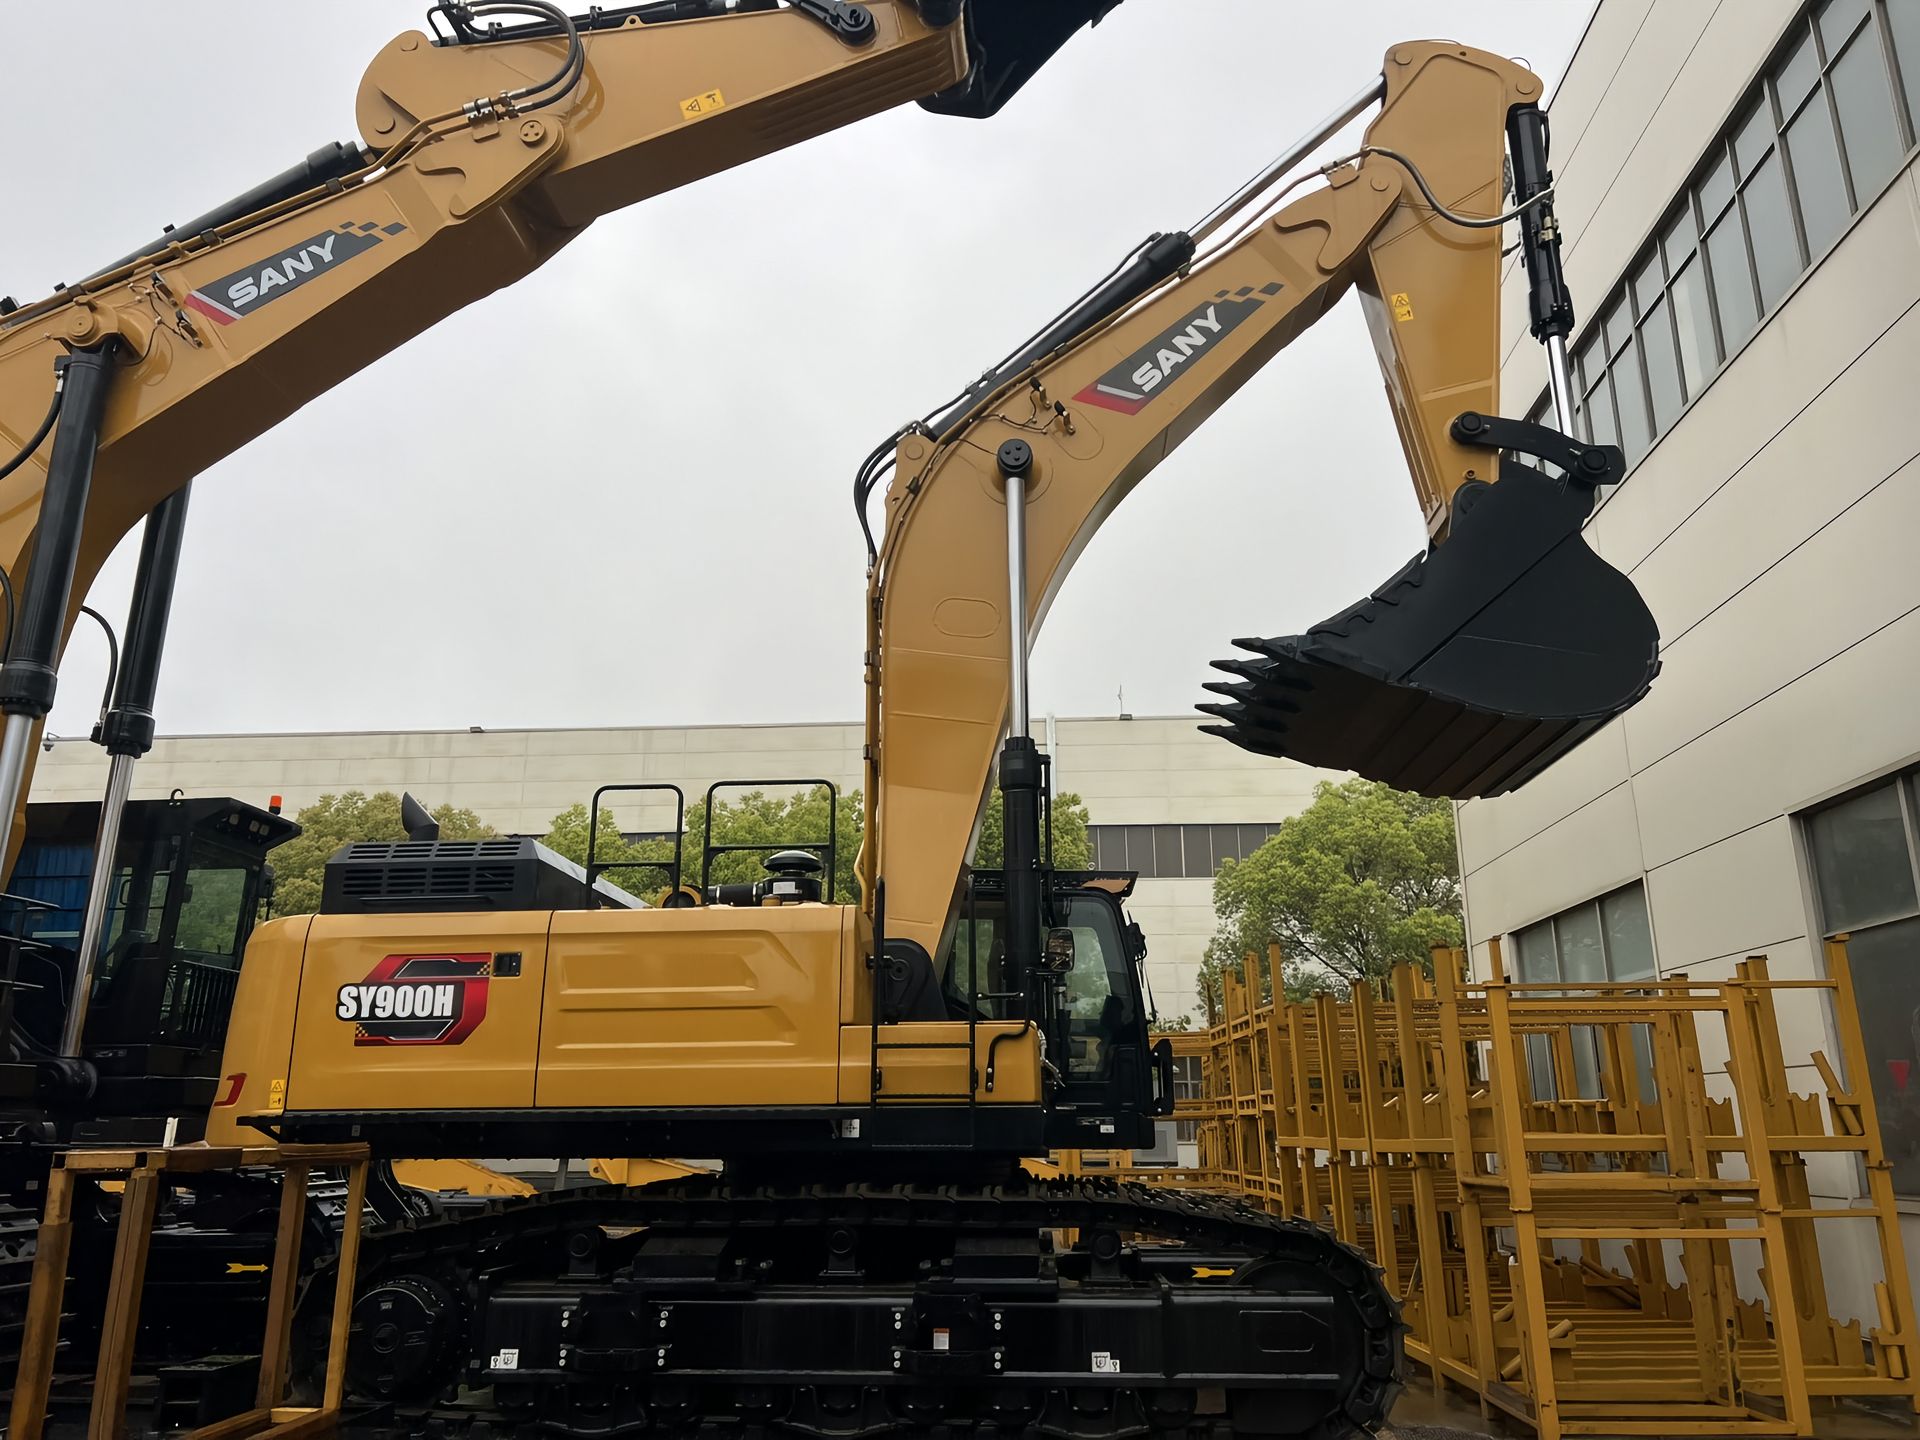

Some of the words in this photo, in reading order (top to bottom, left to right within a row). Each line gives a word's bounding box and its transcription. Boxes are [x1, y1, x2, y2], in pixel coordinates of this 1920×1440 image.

[227, 234, 335, 308] SANY
[1132, 305, 1222, 392] SANY
[338, 984, 455, 1018] SY900H
